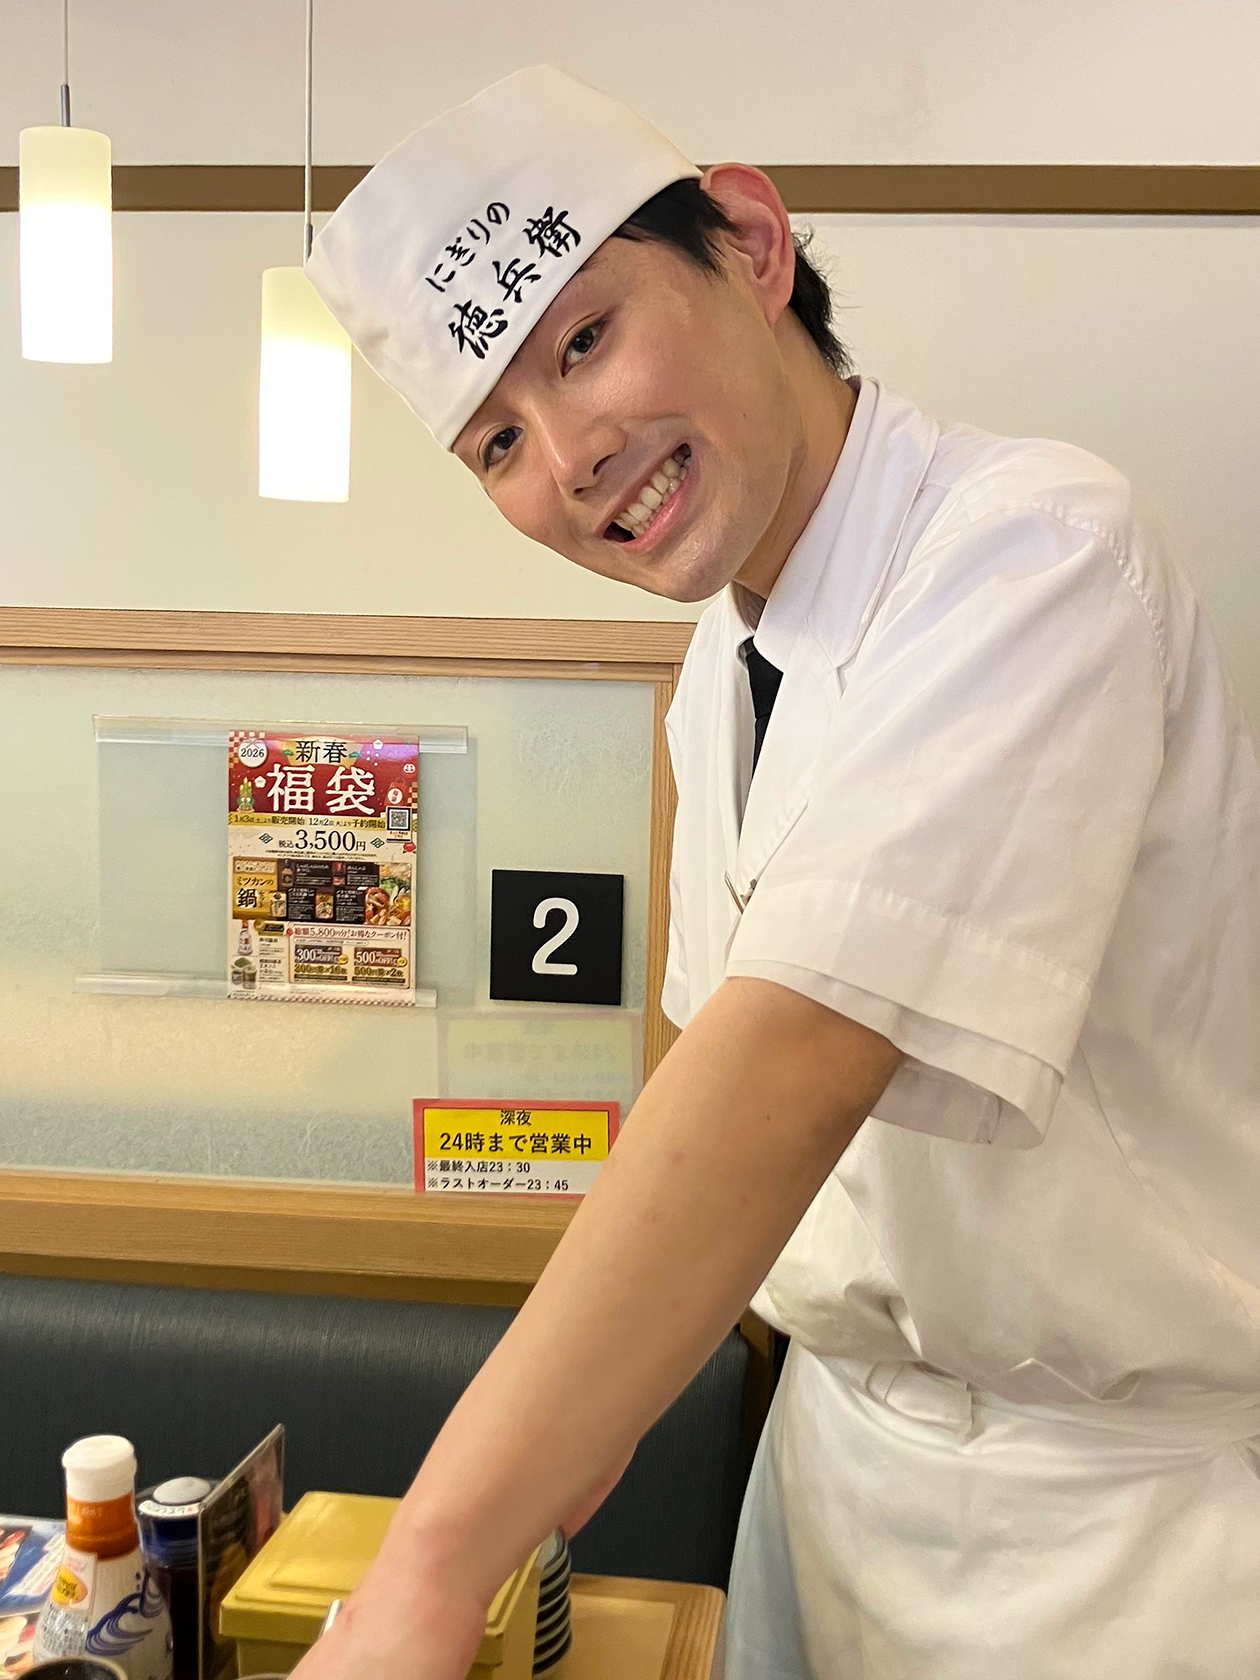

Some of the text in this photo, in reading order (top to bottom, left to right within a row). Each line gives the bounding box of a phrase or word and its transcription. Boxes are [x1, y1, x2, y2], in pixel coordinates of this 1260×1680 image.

[425, 202, 510, 292] にぎりの
[448, 206, 581, 359] 徳兵衛
[240, 748, 265, 758] 2026
[295, 740, 348, 764] 新春
[266, 763, 376, 815] 福袋
[278, 829, 366, 851] 税込3,500円
[237, 888, 257, 908] 鍋
[532, 897, 579, 976] 2
[500, 1109, 532, 1126] 深夜
[440, 1132, 592, 1155] 24時まで営業中
